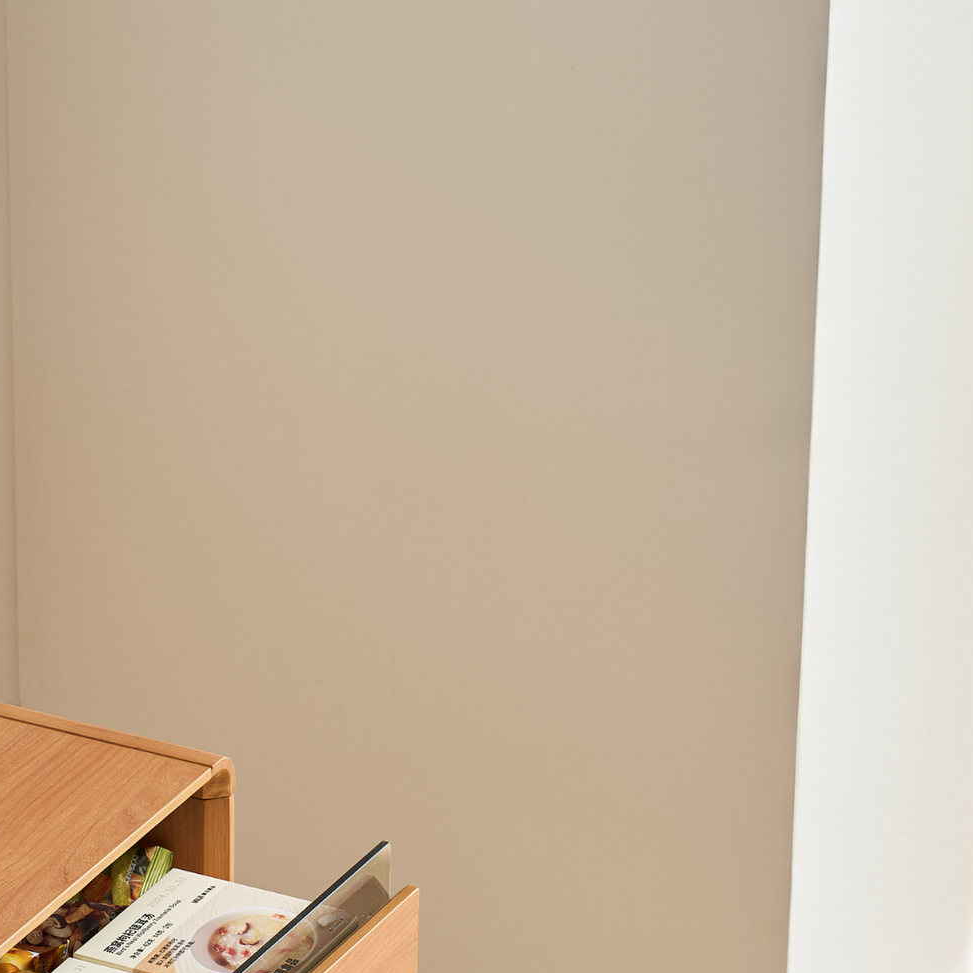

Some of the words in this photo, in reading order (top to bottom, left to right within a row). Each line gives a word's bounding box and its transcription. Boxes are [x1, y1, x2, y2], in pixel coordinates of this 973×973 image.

[145, 876, 188, 908] 2024.10.31
[152, 907, 172, 921] Tremella
[167, 898, 183, 908] Soup
[103, 912, 156, 953] 燕窝枸杞银耳汤
